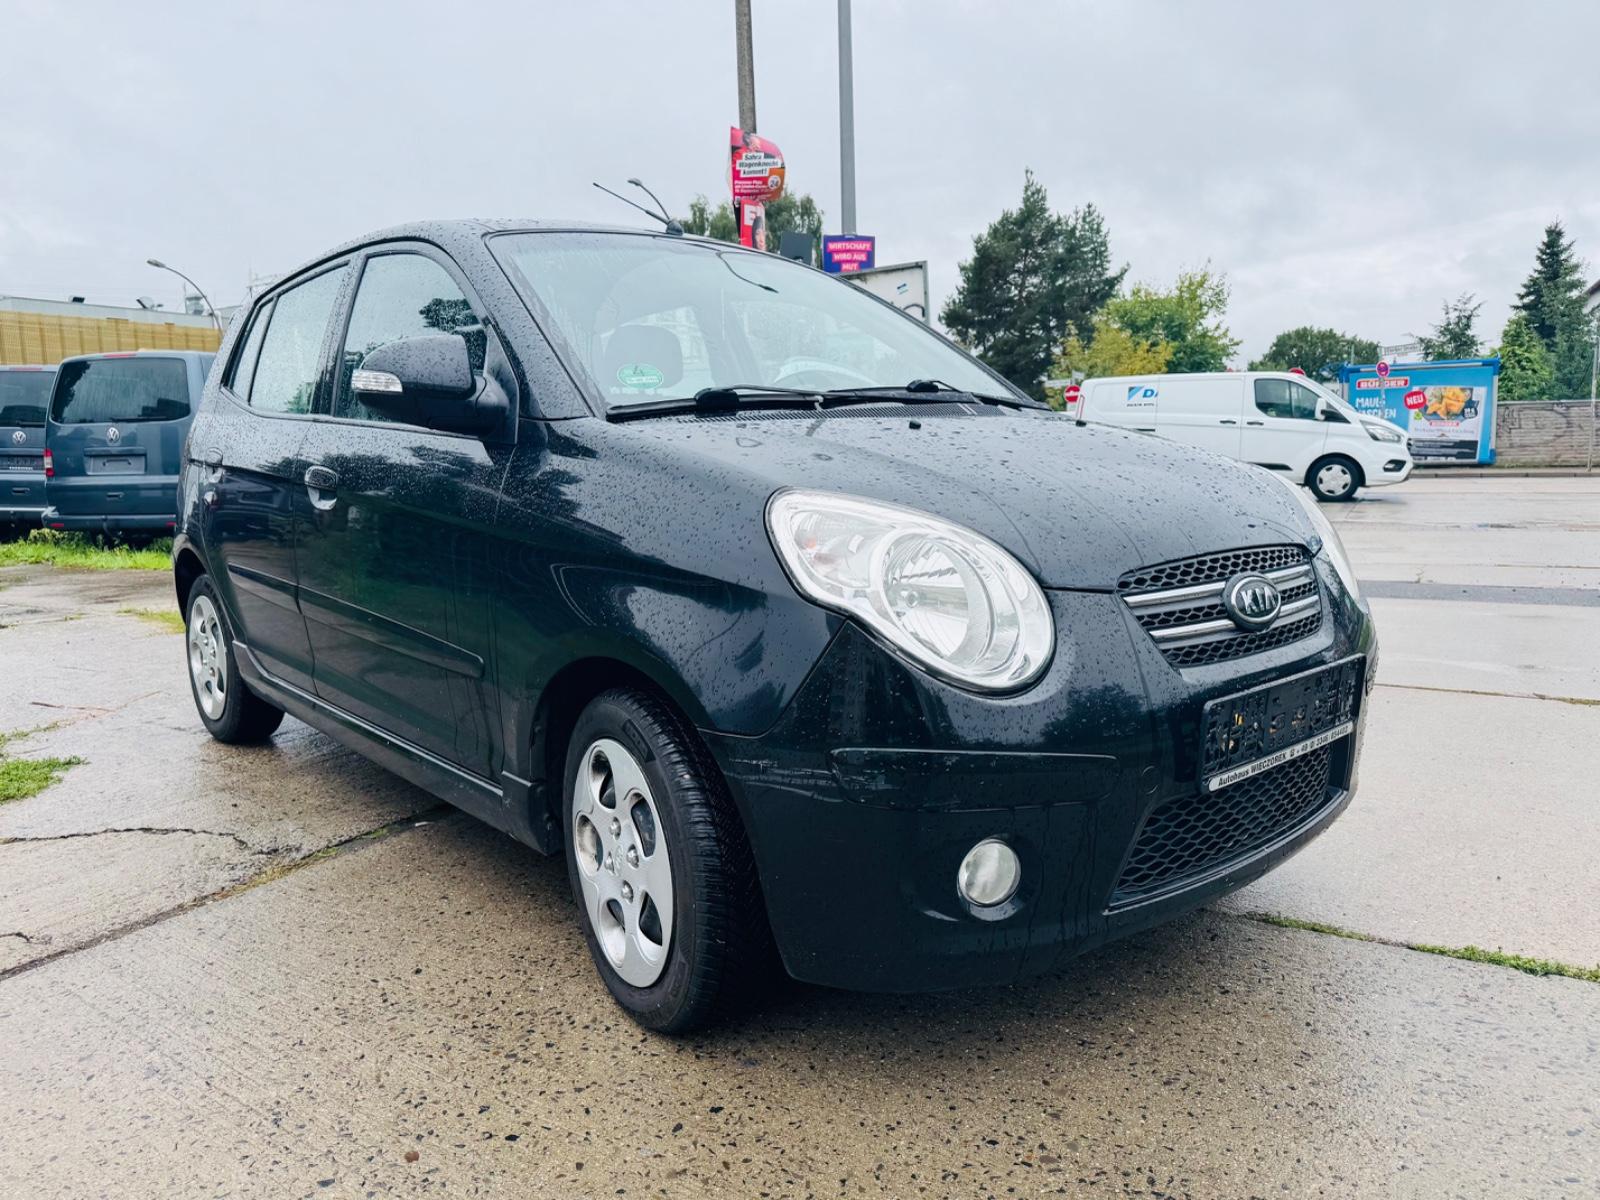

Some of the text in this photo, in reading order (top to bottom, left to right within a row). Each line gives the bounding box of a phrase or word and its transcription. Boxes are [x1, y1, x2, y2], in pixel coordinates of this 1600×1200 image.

[744, 153, 763, 161] Sahra
[1406, 394, 1424, 406] NEU
[1218, 769, 1249, 787] Autohaus
